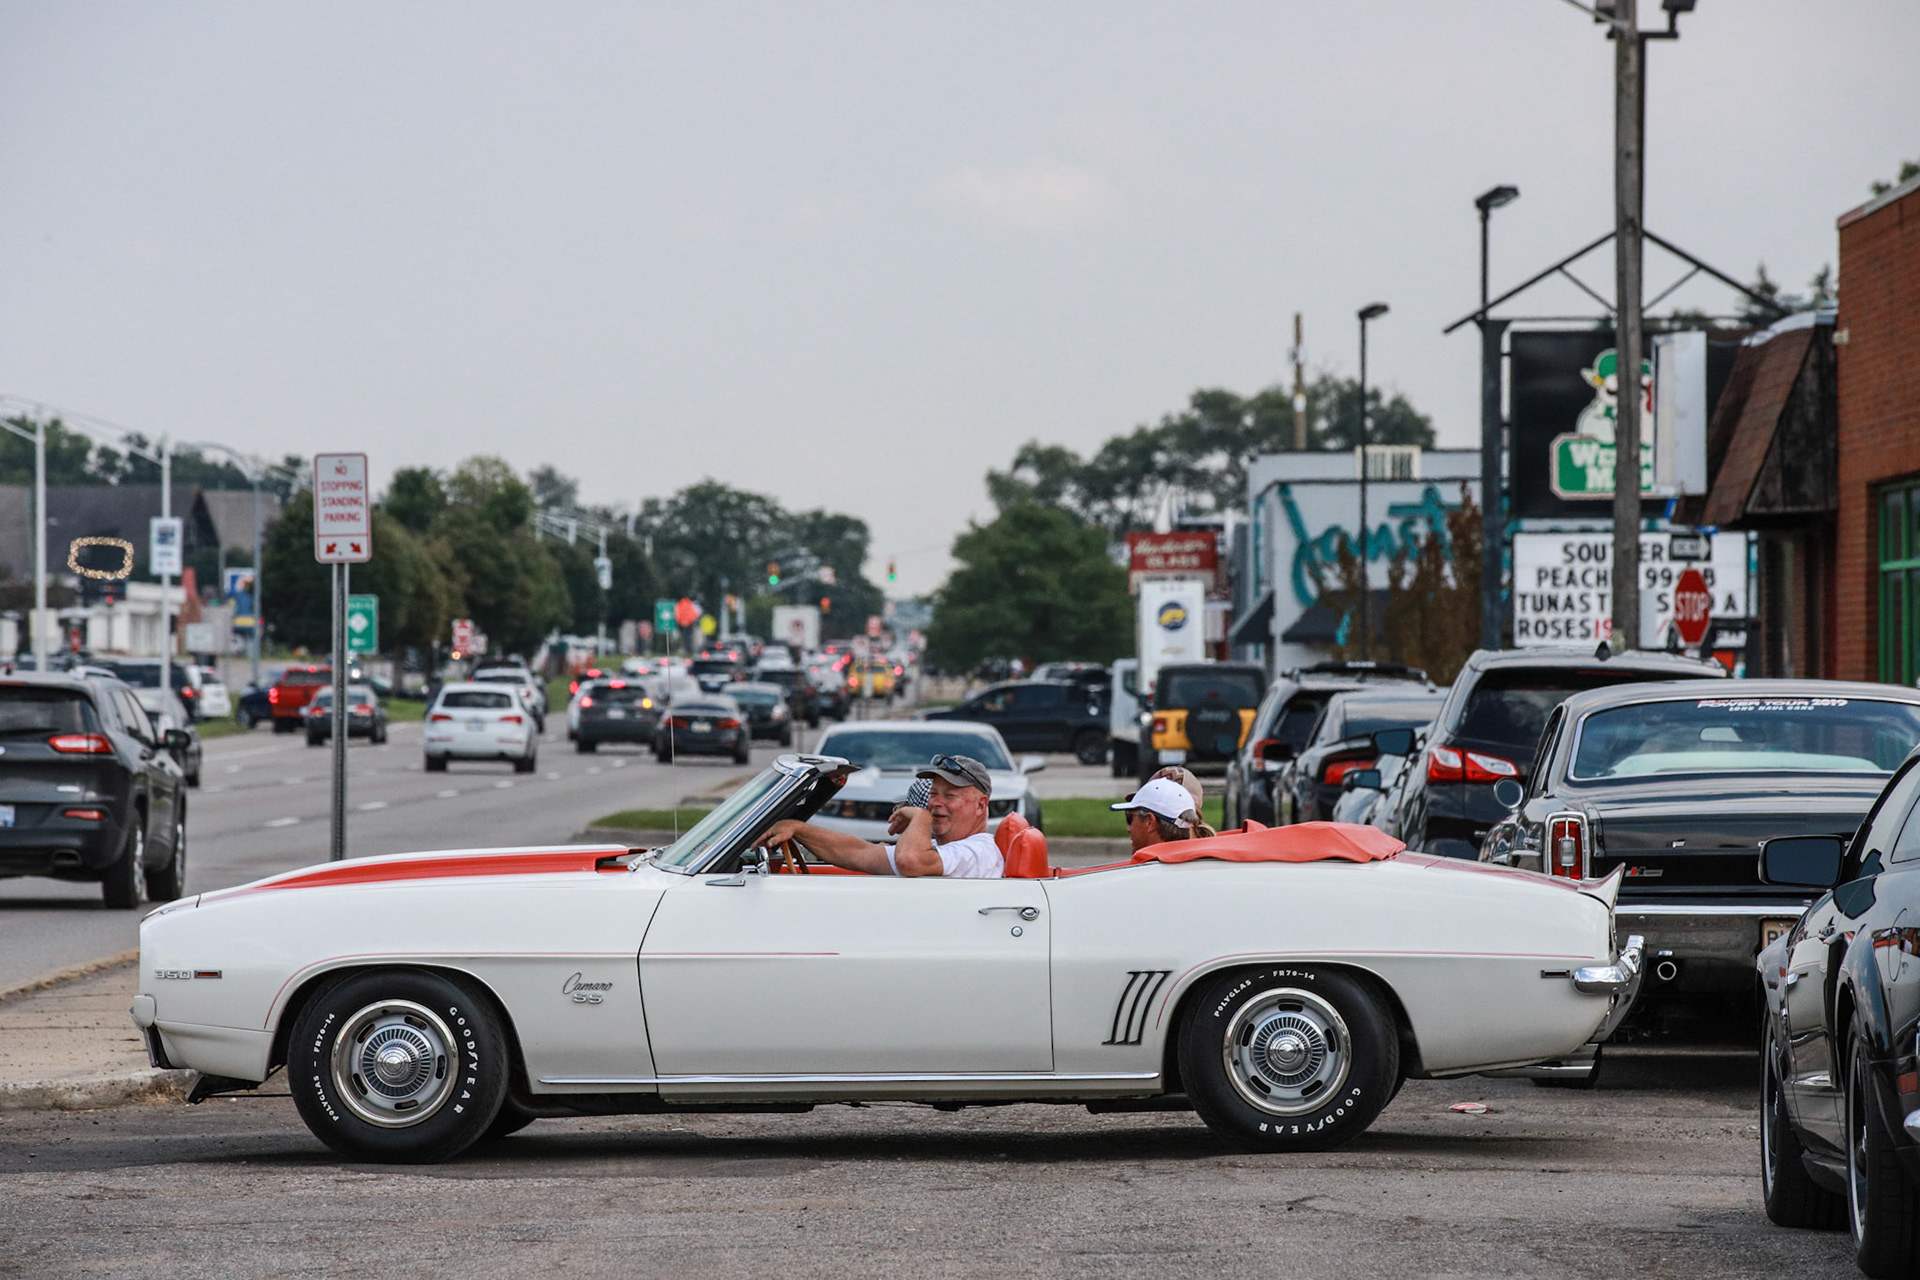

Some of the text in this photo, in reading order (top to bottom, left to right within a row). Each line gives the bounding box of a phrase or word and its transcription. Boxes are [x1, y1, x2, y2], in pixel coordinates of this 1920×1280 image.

[334, 465, 348, 476] NO
[321, 480, 363, 492] STOPPING
[322, 496, 363, 508] STANDING
[324, 512, 361, 523] PARKING
[1676, 591, 1710, 622] STOP
[1518, 619, 1591, 640] ROSES
[155, 969, 191, 979] 350
[563, 972, 613, 995] Camaro
[573, 993, 604, 1004] SS
[1213, 979, 1252, 1018] POLYGLAS
[1272, 970, 1315, 980] FR70-14
[313, 1012, 336, 1053] FR70-14
[449, 1006, 479, 1114] GOODYEAR
[312, 1075, 339, 1122] POLYGLAS
[1259, 1087, 1361, 1134] GOODYEAR
